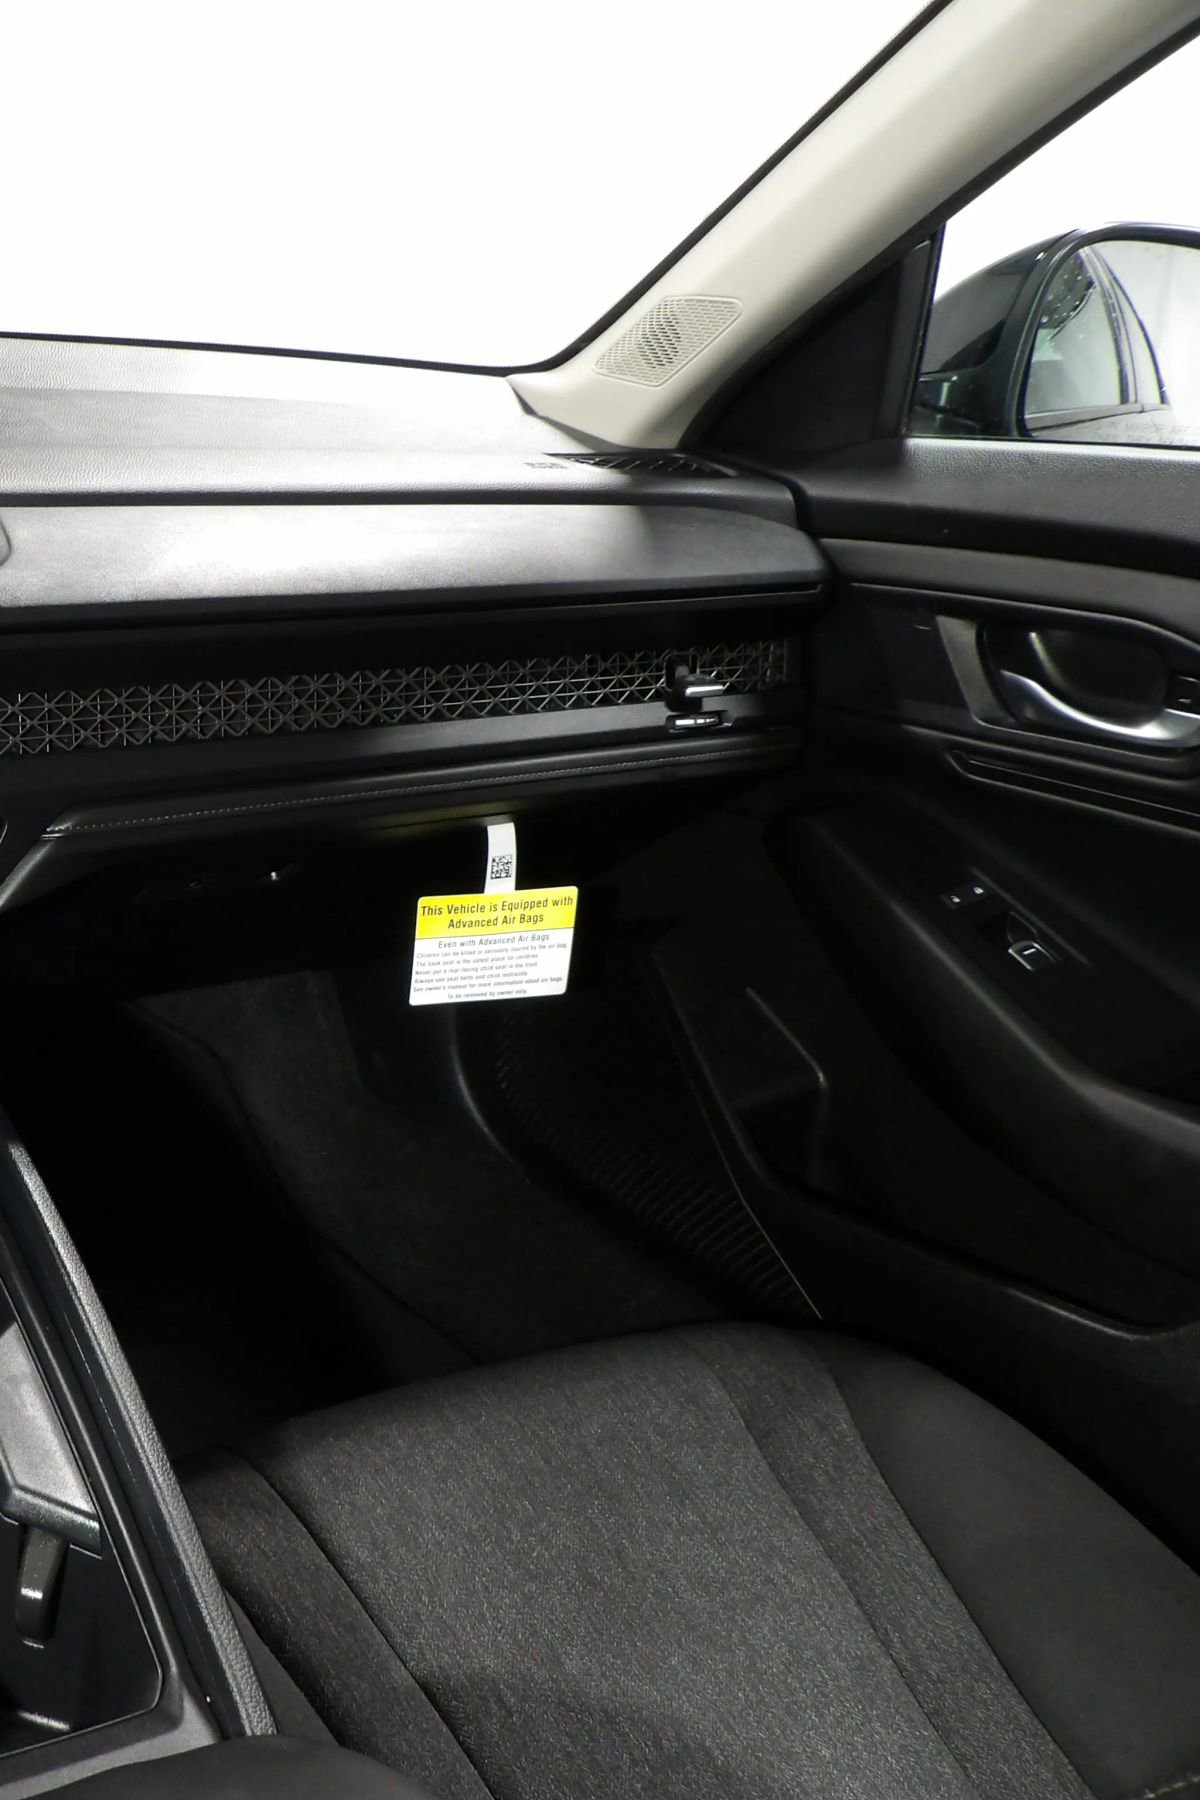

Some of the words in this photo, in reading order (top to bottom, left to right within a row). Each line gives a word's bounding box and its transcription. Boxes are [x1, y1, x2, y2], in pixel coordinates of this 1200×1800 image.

[421, 904, 443, 917] This
[447, 903, 486, 915] Vehicle
[489, 902, 498, 912] is
[501, 897, 548, 912] Equipped
[552, 896, 574, 907] with
[448, 915, 498, 929] Advanced
[501, 915, 516, 925] Air
[519, 913, 544, 925] Bags
[438, 940, 457, 949] Even
[460, 939, 476, 947] with
[478, 935, 516, 946] Advanced
[517, 934, 529, 942] Air
[531, 933, 550, 942] Bags
